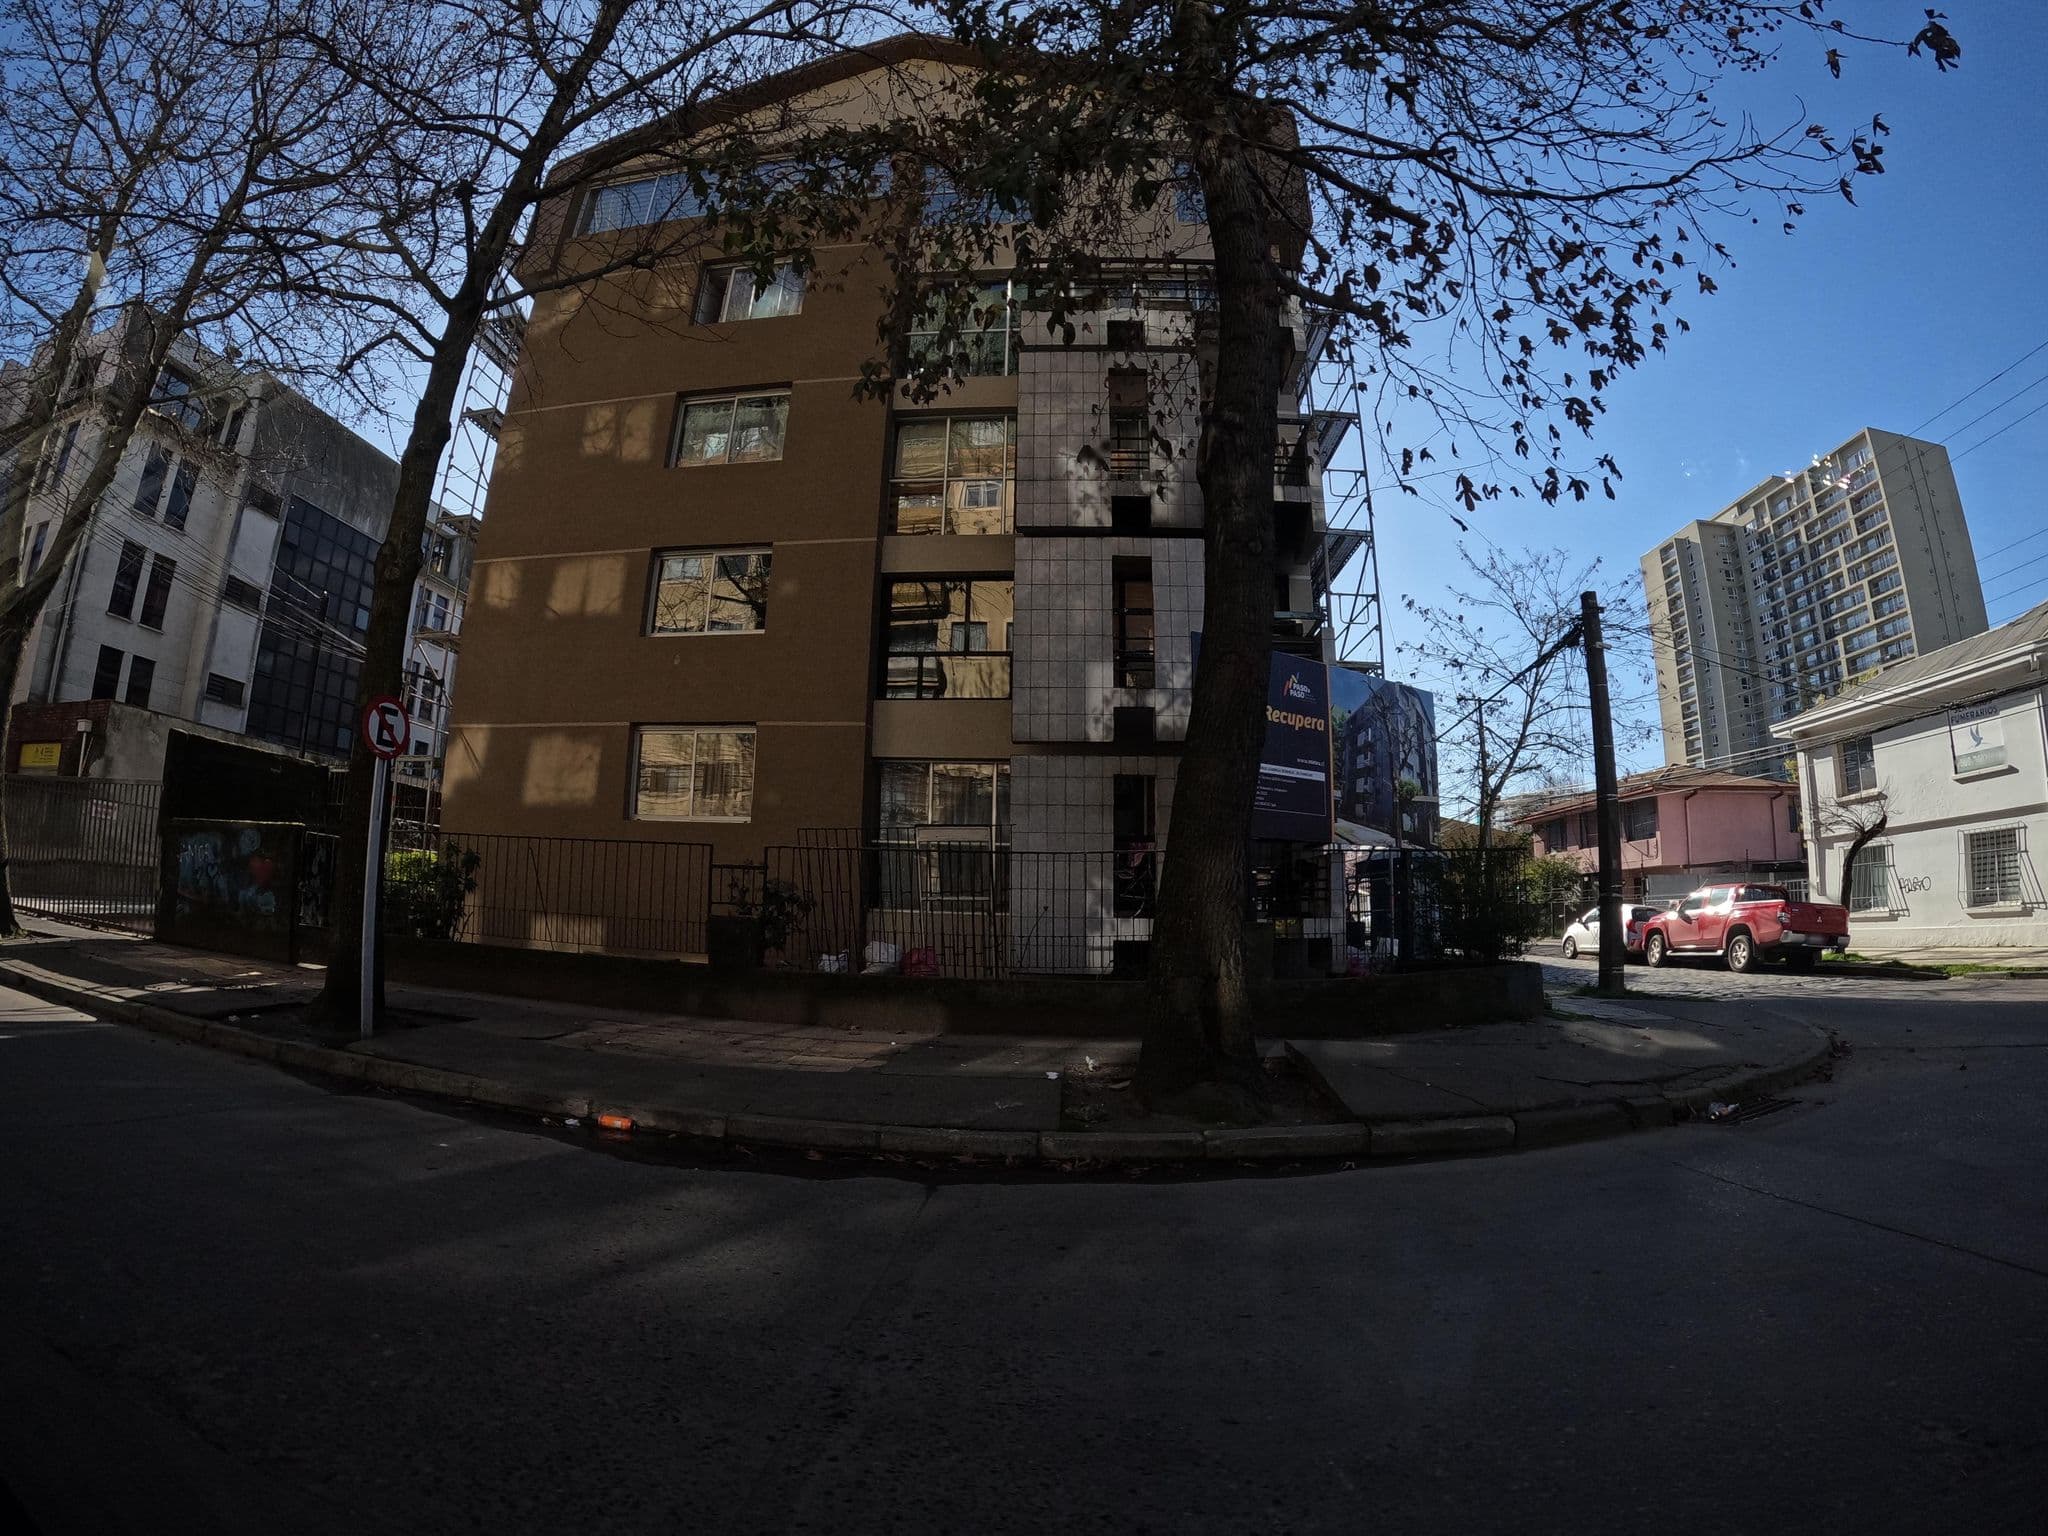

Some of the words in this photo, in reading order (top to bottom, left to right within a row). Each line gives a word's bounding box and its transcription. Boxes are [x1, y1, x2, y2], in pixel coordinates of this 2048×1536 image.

[1289, 689, 1305, 698] PASO
[1293, 683, 1308, 693] PASO
[1265, 704, 1325, 732] Recupera
[1951, 705, 1998, 724] FUNERARIOS
